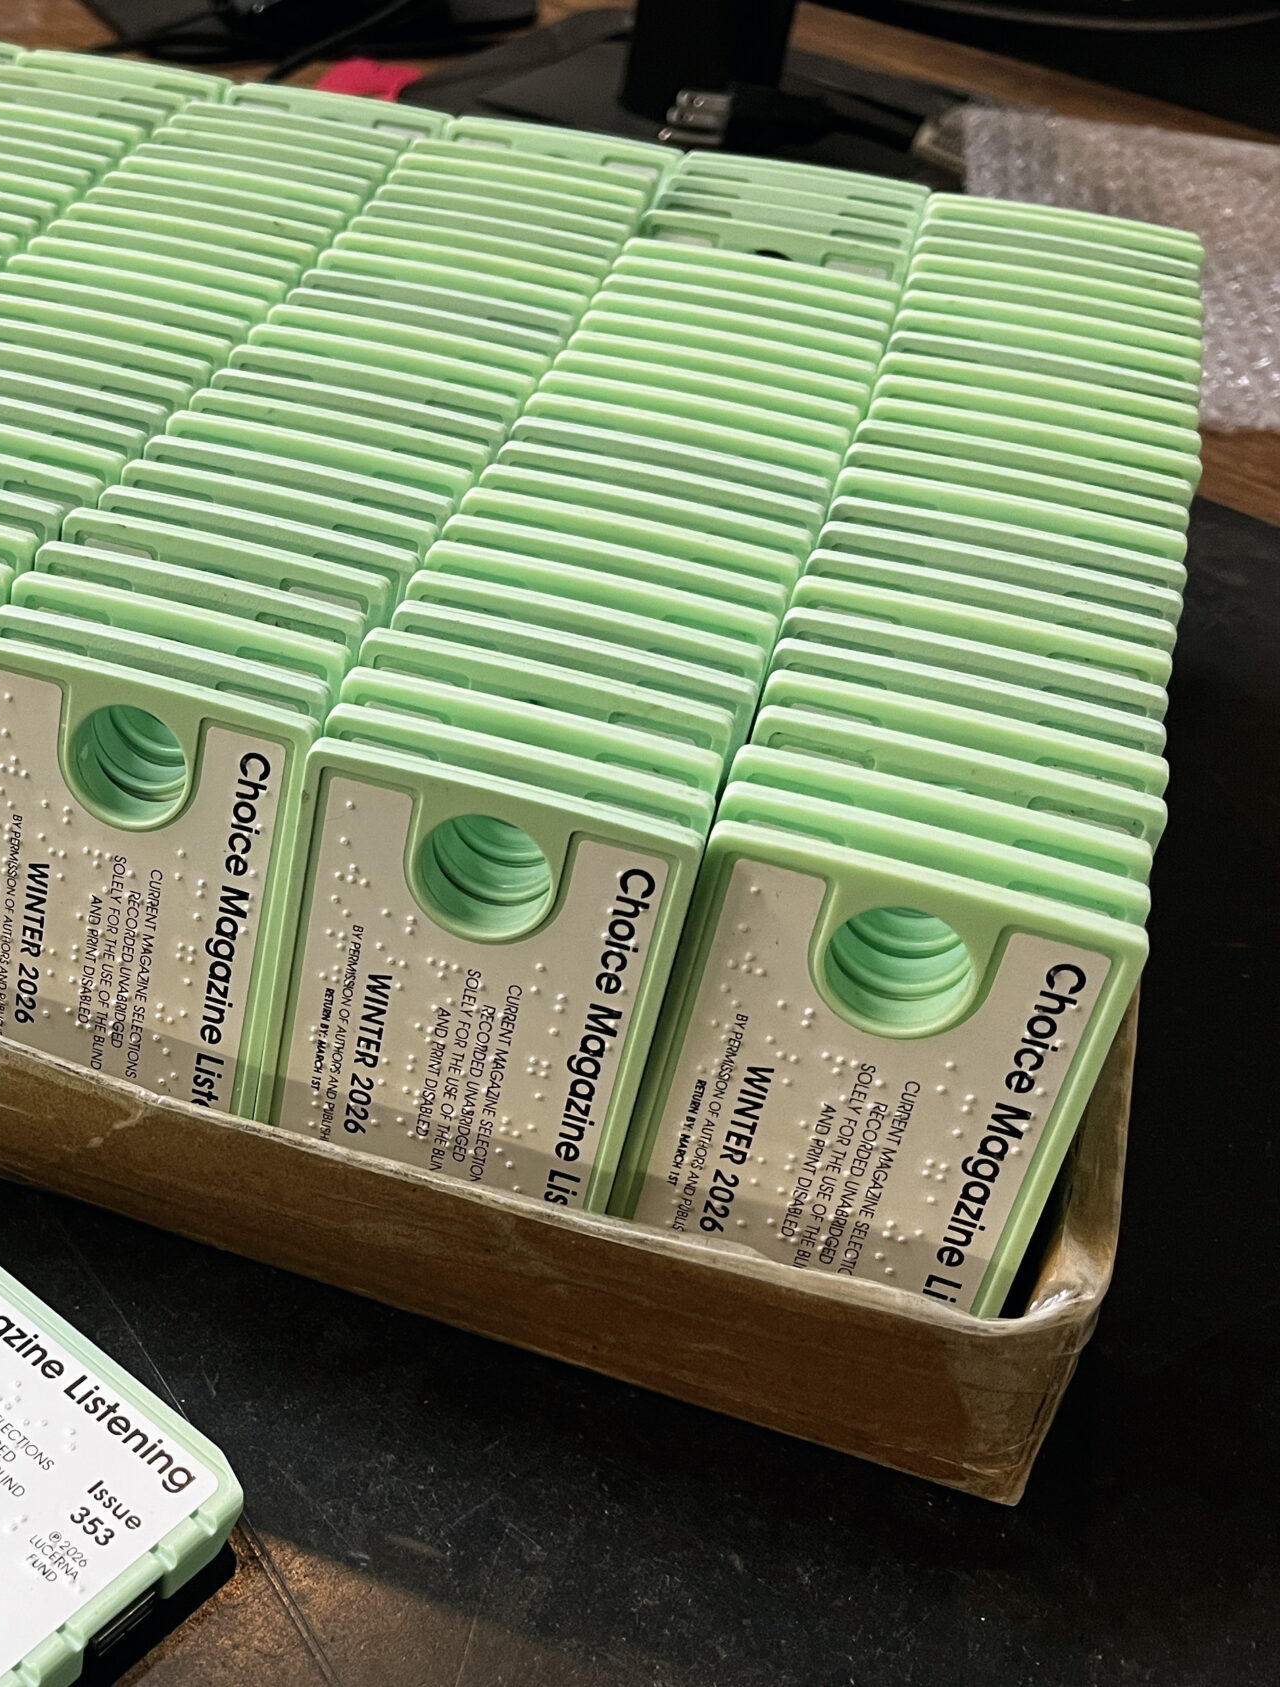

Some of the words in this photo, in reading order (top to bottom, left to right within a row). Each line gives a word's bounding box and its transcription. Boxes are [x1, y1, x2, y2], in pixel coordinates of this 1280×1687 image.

[223, 750, 271, 879] Choice
[109, 854, 127, 904] SOLELY
[144, 868, 163, 931] CURRENT
[19, 862, 50, 958] WINTER
[88, 893, 103, 925] AND
[105, 906, 121, 935] FOR
[120, 889, 142, 964] RECORDED
[594, 867, 656, 997] Choice
[84, 926, 100, 963] PRINT
[102, 938, 117, 960] THE
[134, 932, 155, 1002] MAGAZINE
[199, 884, 251, 1045] Magazine
[13, 961, 39, 1024] 2026
[77, 964, 95, 1024] DISABLED
[97, 989, 110, 1009] OF
[99, 962, 114, 987] USE
[93, 1010, 108, 1032] THE
[110, 966, 131, 1049] UNABRIDGED
[352, 973, 393, 1069] WINTER
[434, 1006, 452, 1038] AND
[497, 983, 523, 1047] CURRENT
[733, 1012, 749, 1029] BY
[1003, 962, 1087, 1098] Choice
[89, 1034, 106, 1070] BLIND
[124, 1004, 146, 1079] SELECTIONS
[427, 1039, 446, 1076] PRINT
[468, 1004, 497, 1078] RECORDED
[711, 1030, 743, 1099] PERMISSION
[342, 1072, 374, 1134] 2026
[415, 1077, 438, 1136] DISABLED
[481, 1047, 509, 1117] MAGAZINE
[553, 1002, 623, 1162] Magazine
[687, 1077, 707, 1115] RETURN
[847, 1063, 877, 1115] SOLELY
[451, 1080, 480, 1162] UNABRIDGED
[682, 1115, 695, 1132] BY:
[707, 1100, 721, 1118] OF
[718, 1065, 775, 1165] WINTER
[815, 1102, 837, 1135] AND
[834, 1116, 858, 1147] FOR
[886, 1080, 921, 1146] CURRENT
[671, 1131, 692, 1169] MARCH
[691, 1118, 715, 1170] AUTHORS
[801, 1136, 827, 1175] PRINT
[825, 1149, 847, 1173] THE
[849, 1100, 889, 1178] RECORDED
[667, 1170, 680, 1186] 1ST
[683, 1169, 700, 1197] AND
[698, 1168, 739, 1233] 2026
[815, 1175, 838, 1201] USE
[858, 1146, 897, 1219] MAGAZINE
[935, 1101, 1032, 1268] Magazine
[781, 1175, 813, 1237] DISABLED
[810, 1202, 827, 1223] OF
[818, 1179, 859, 1265] UNABRIDGED
[800, 1224, 821, 1247] THE
[61, 1373, 197, 1494] Listening
[69, 1505, 115, 1546] 353
[86, 1478, 142, 1530] Issue
[27, 1552, 58, 1582] FUND
[28, 1534, 78, 1581] LUCERNA
